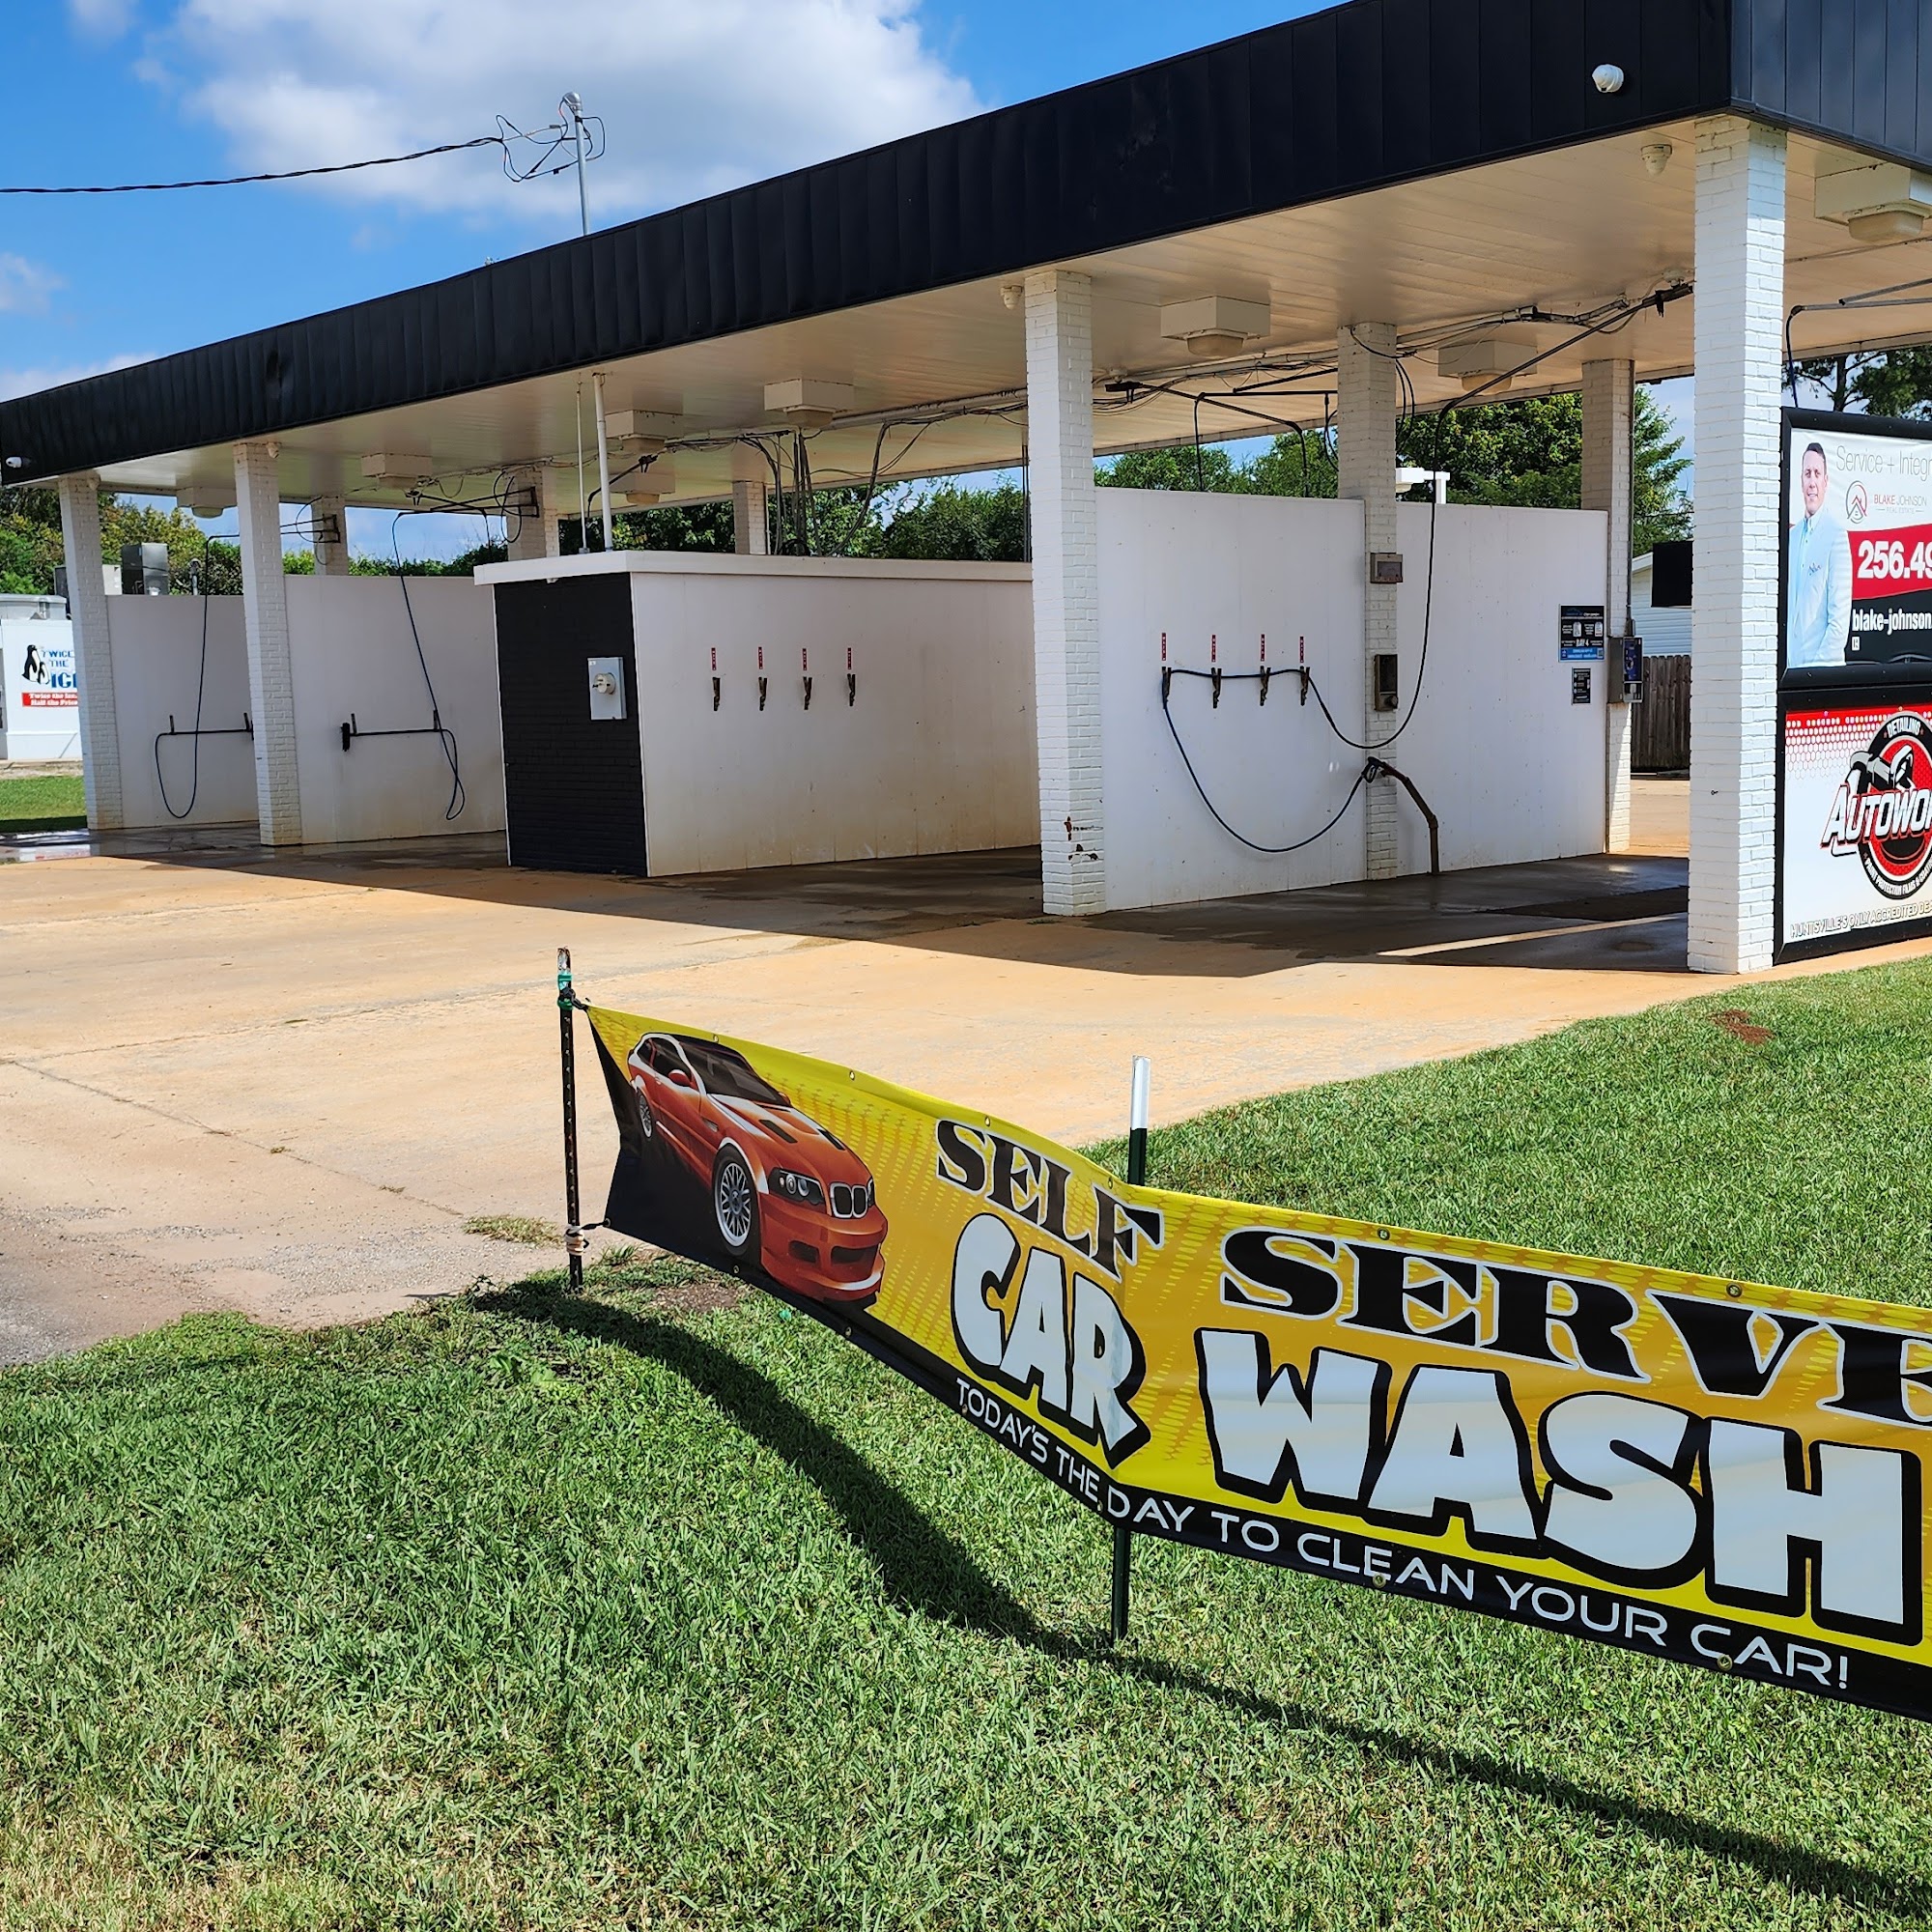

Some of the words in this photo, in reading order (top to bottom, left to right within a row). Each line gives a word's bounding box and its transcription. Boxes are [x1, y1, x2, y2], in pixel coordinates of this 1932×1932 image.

[1836, 445, 1883, 473] Service
[1874, 494, 1896, 504] BLAKE
[1896, 495, 1927, 506] JOHNSON
[1887, 717, 1921, 738] DETAILING
[1849, 911, 1871, 928] ONLY
[1870, 903, 1918, 923] ACCREDITED
[936, 1119, 1164, 1283] SELF
[1220, 1225, 1932, 1429] SERVE
[951, 1212, 1151, 1470] CAR
[1194, 1327, 1923, 1647] WASH
[955, 1377, 1049, 1464] TODAY'S
[1055, 1444, 1101, 1504] THE
[1107, 1484, 1196, 1533] DAY
[1210, 1511, 1281, 1552] TO
[1296, 1532, 1474, 1602] CLEAN
[1494, 1575, 1668, 1647] YOUR
[1690, 1623, 1849, 1690] CAR!
